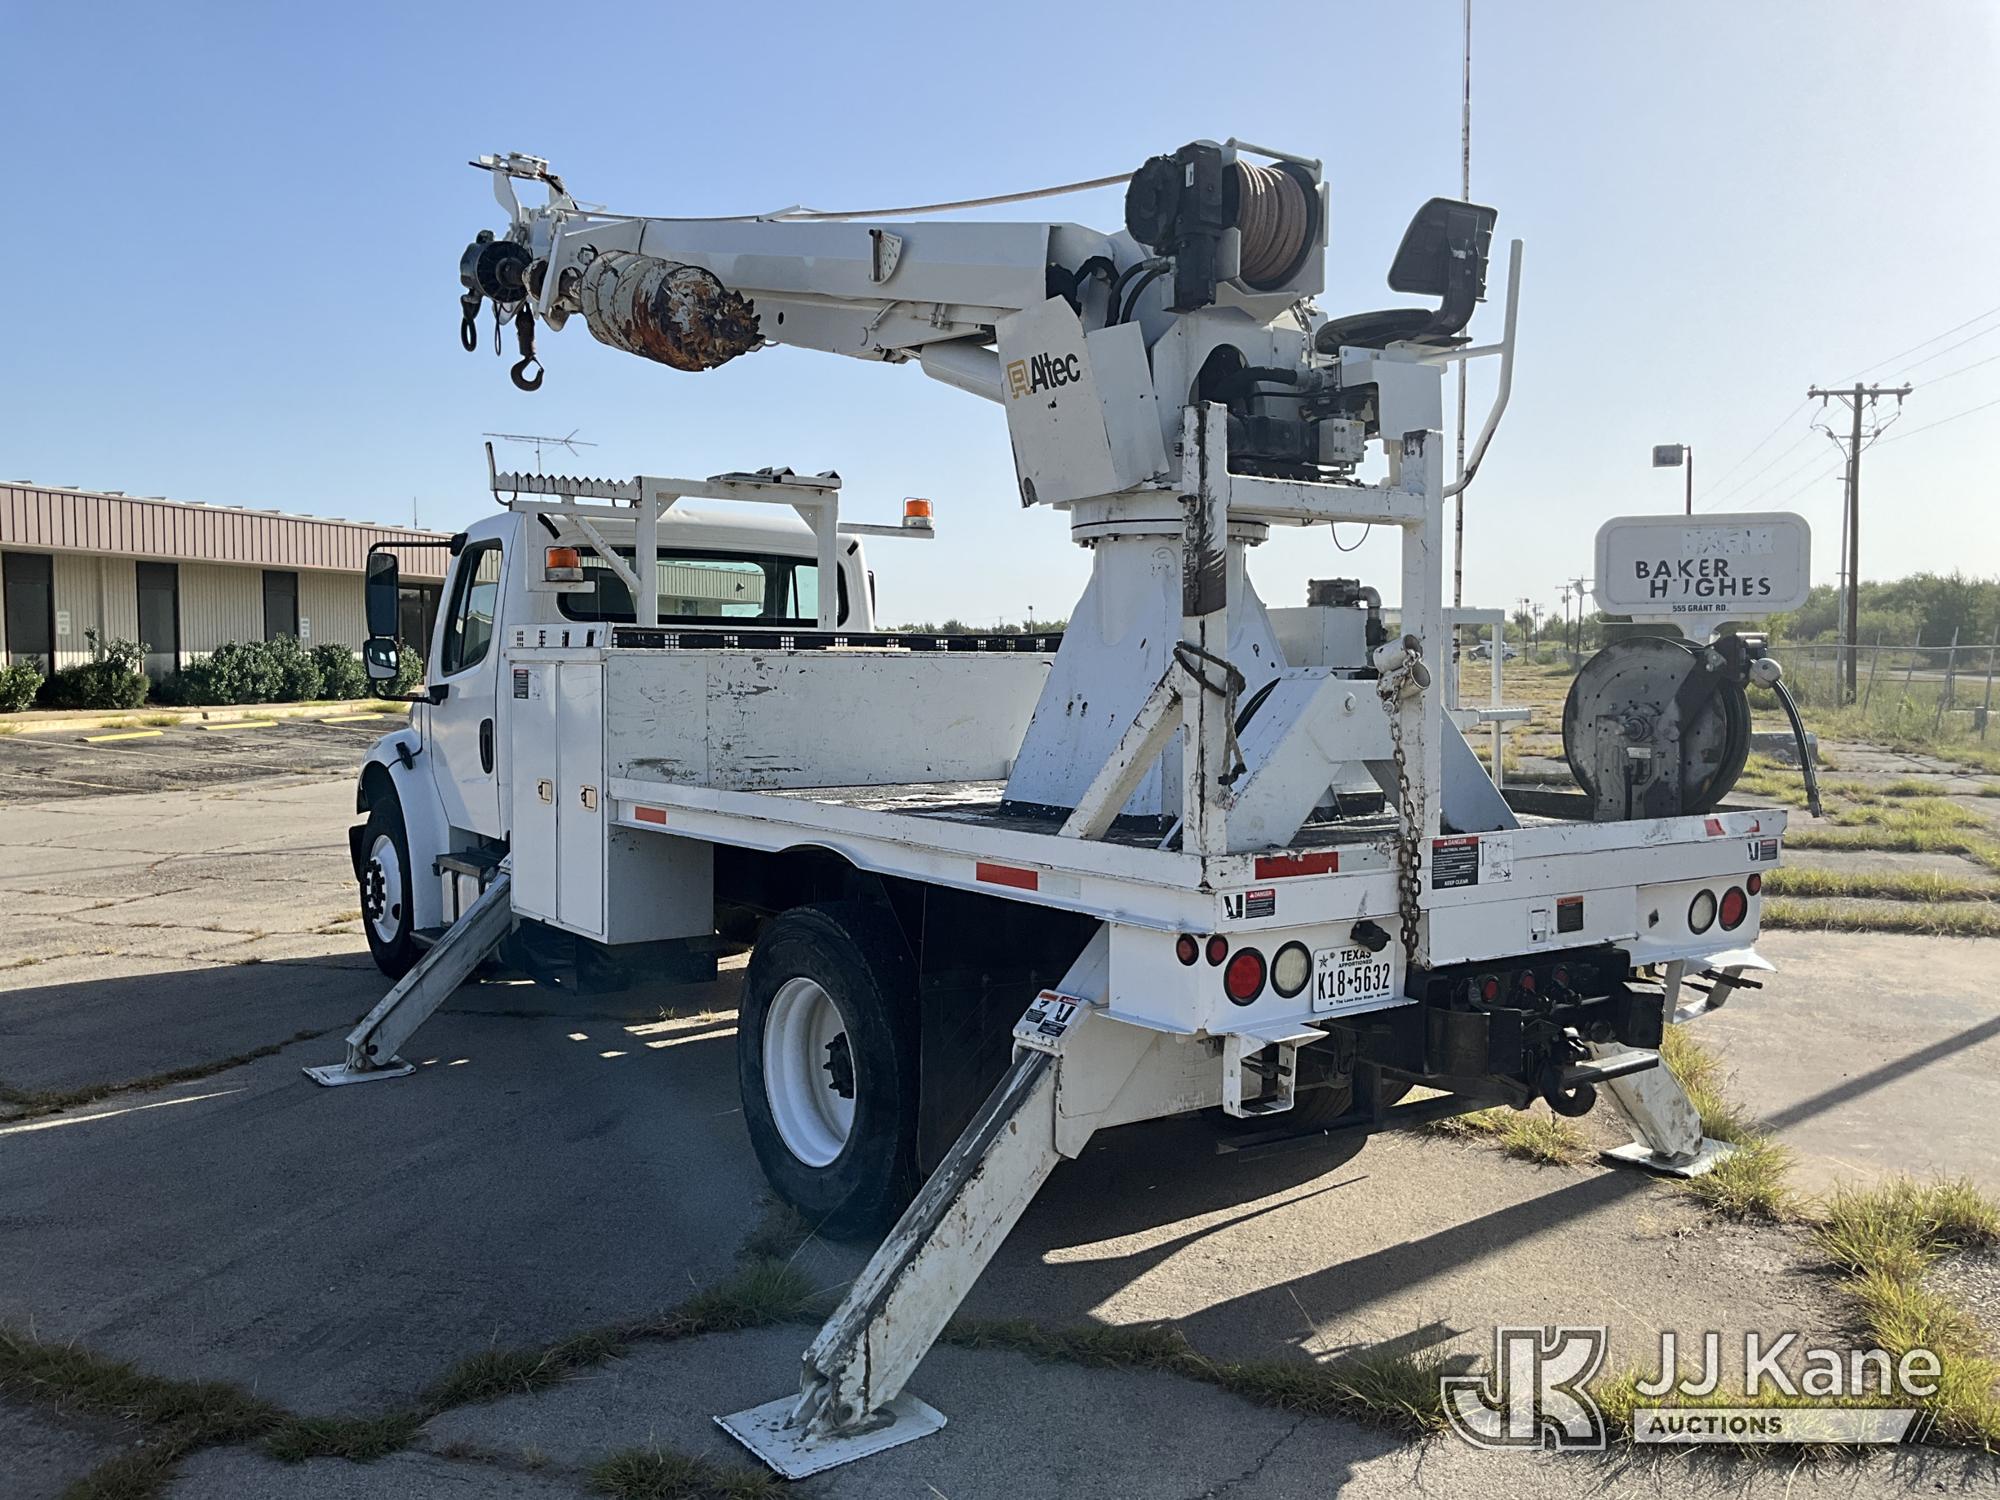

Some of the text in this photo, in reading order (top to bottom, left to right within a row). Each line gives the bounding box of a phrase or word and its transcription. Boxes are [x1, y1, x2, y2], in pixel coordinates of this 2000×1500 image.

[1030, 352, 1081, 394] Altec
[1635, 558, 1730, 579] BAKER
[1672, 604, 1687, 613] 555
[1688, 604, 1713, 612] GRANT
[1340, 949, 1372, 961] TEXAS
